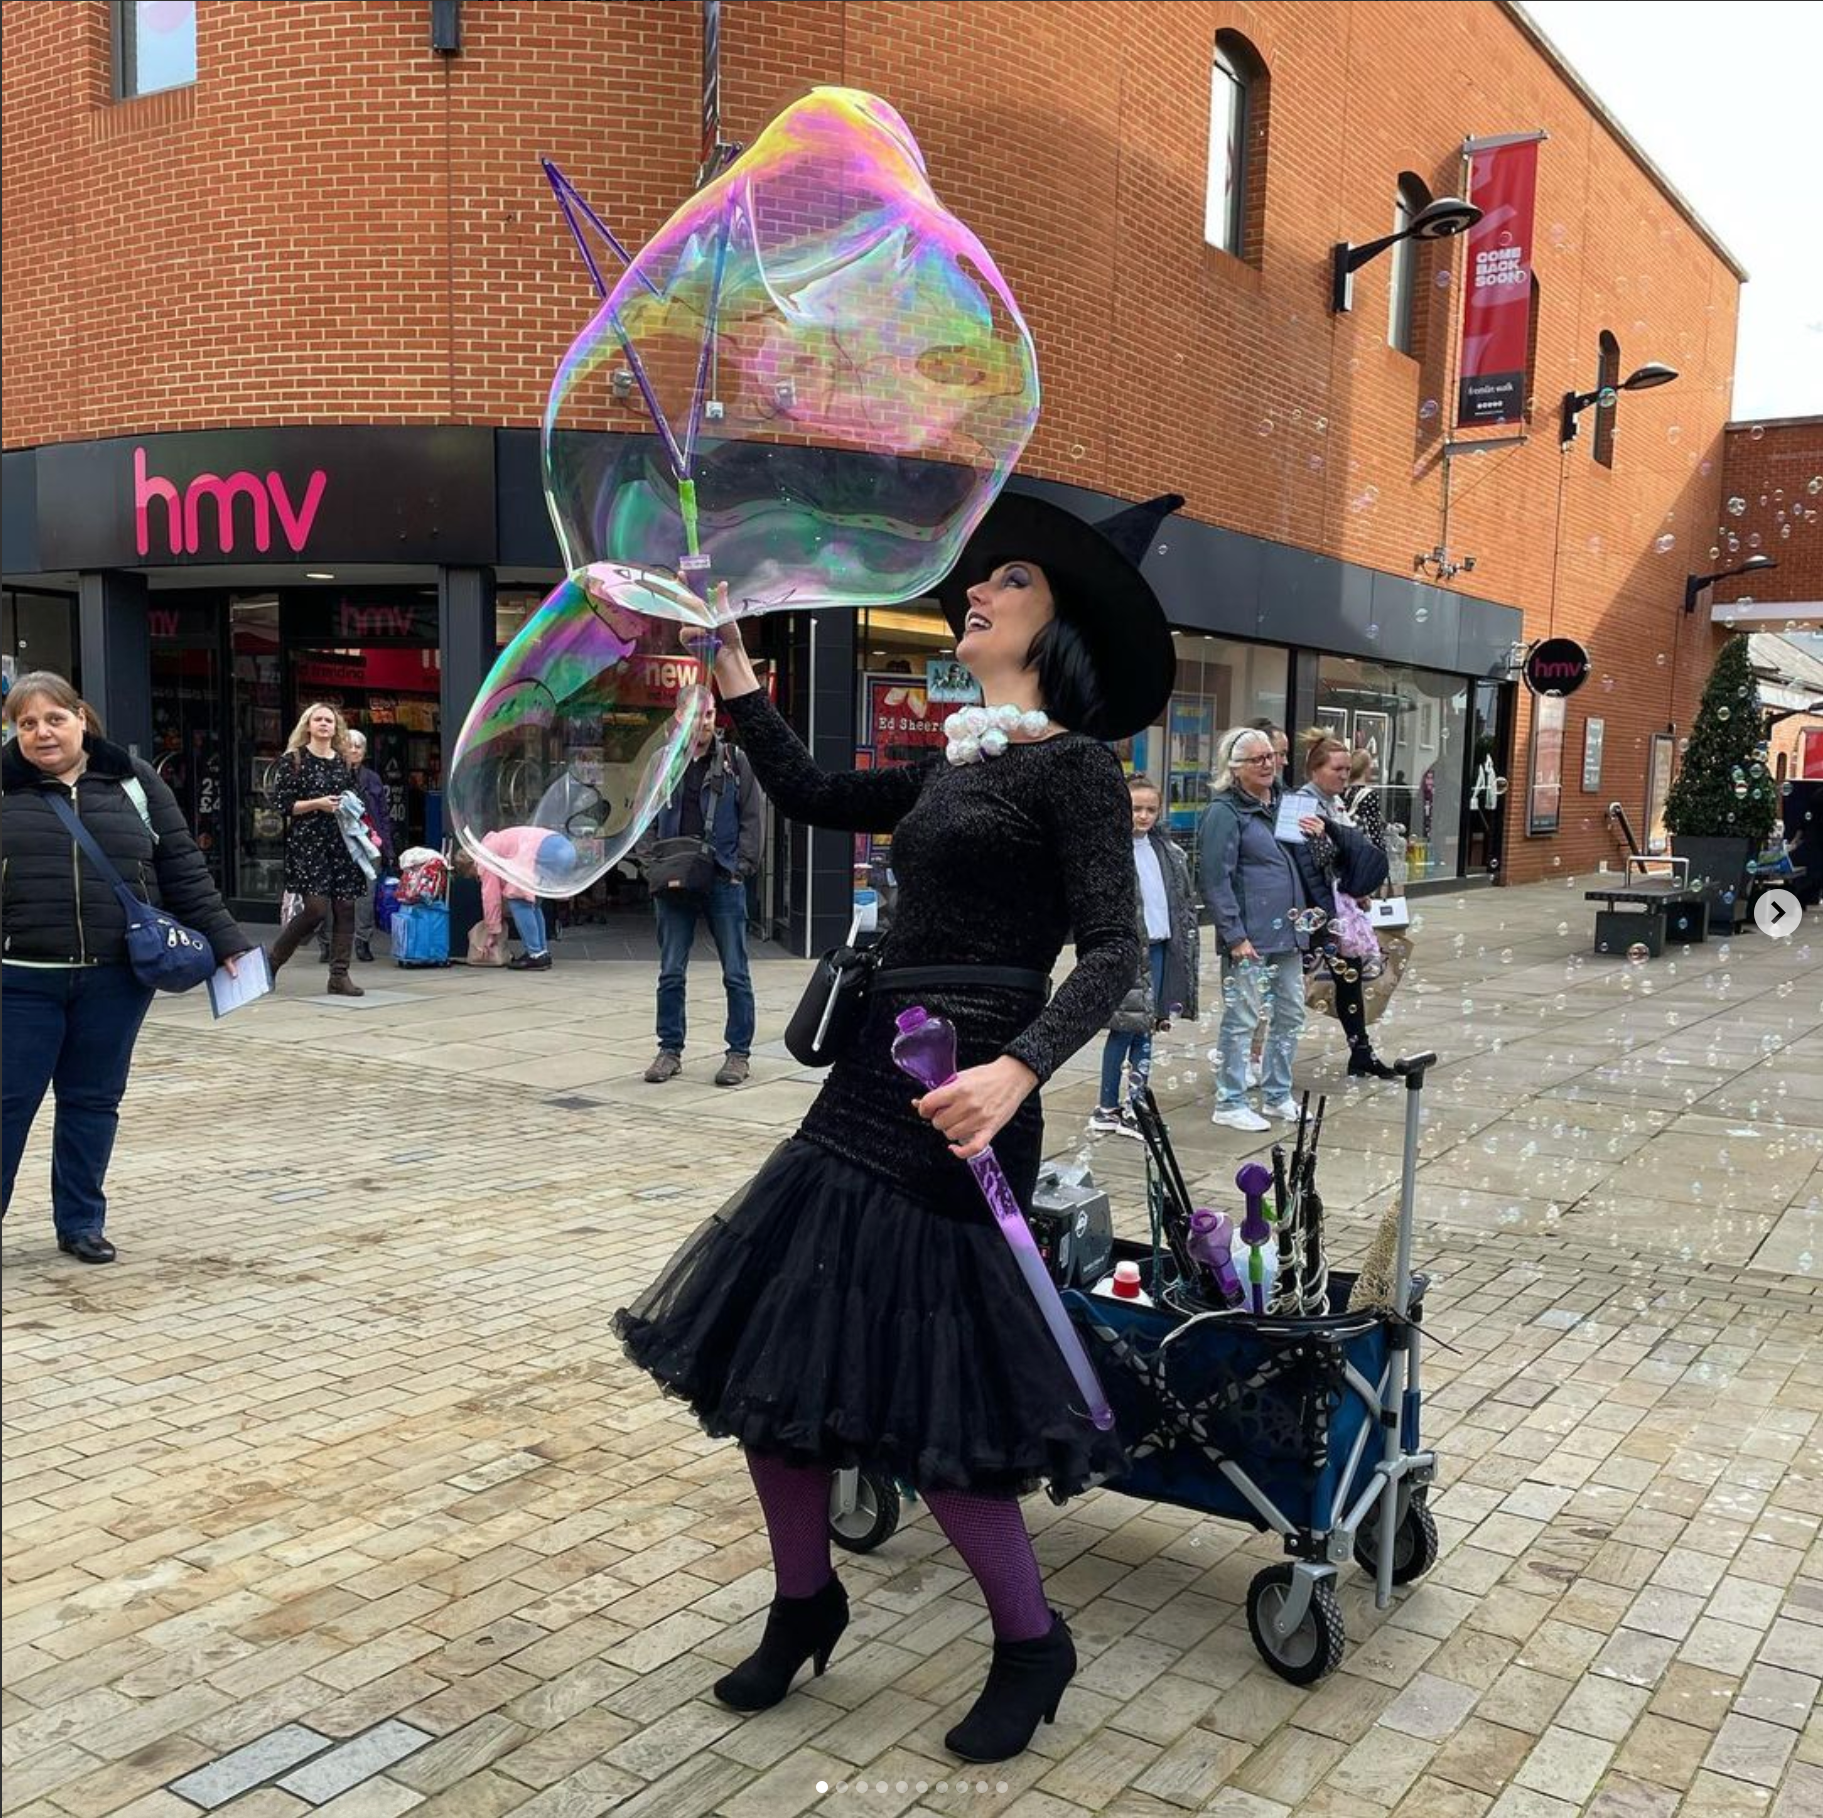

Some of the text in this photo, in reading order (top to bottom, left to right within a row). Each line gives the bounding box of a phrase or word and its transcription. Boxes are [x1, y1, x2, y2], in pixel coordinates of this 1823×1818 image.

[1476, 247, 1521, 263] COME
[1476, 259, 1519, 275] BACK
[134, 446, 327, 556] hmv
[339, 598, 414, 637] hmv
[646, 661, 698, 689] new
[1534, 657, 1582, 678] hmv
[878, 717, 945, 733] Ed Sheera
[199, 796, 221, 814] £4
